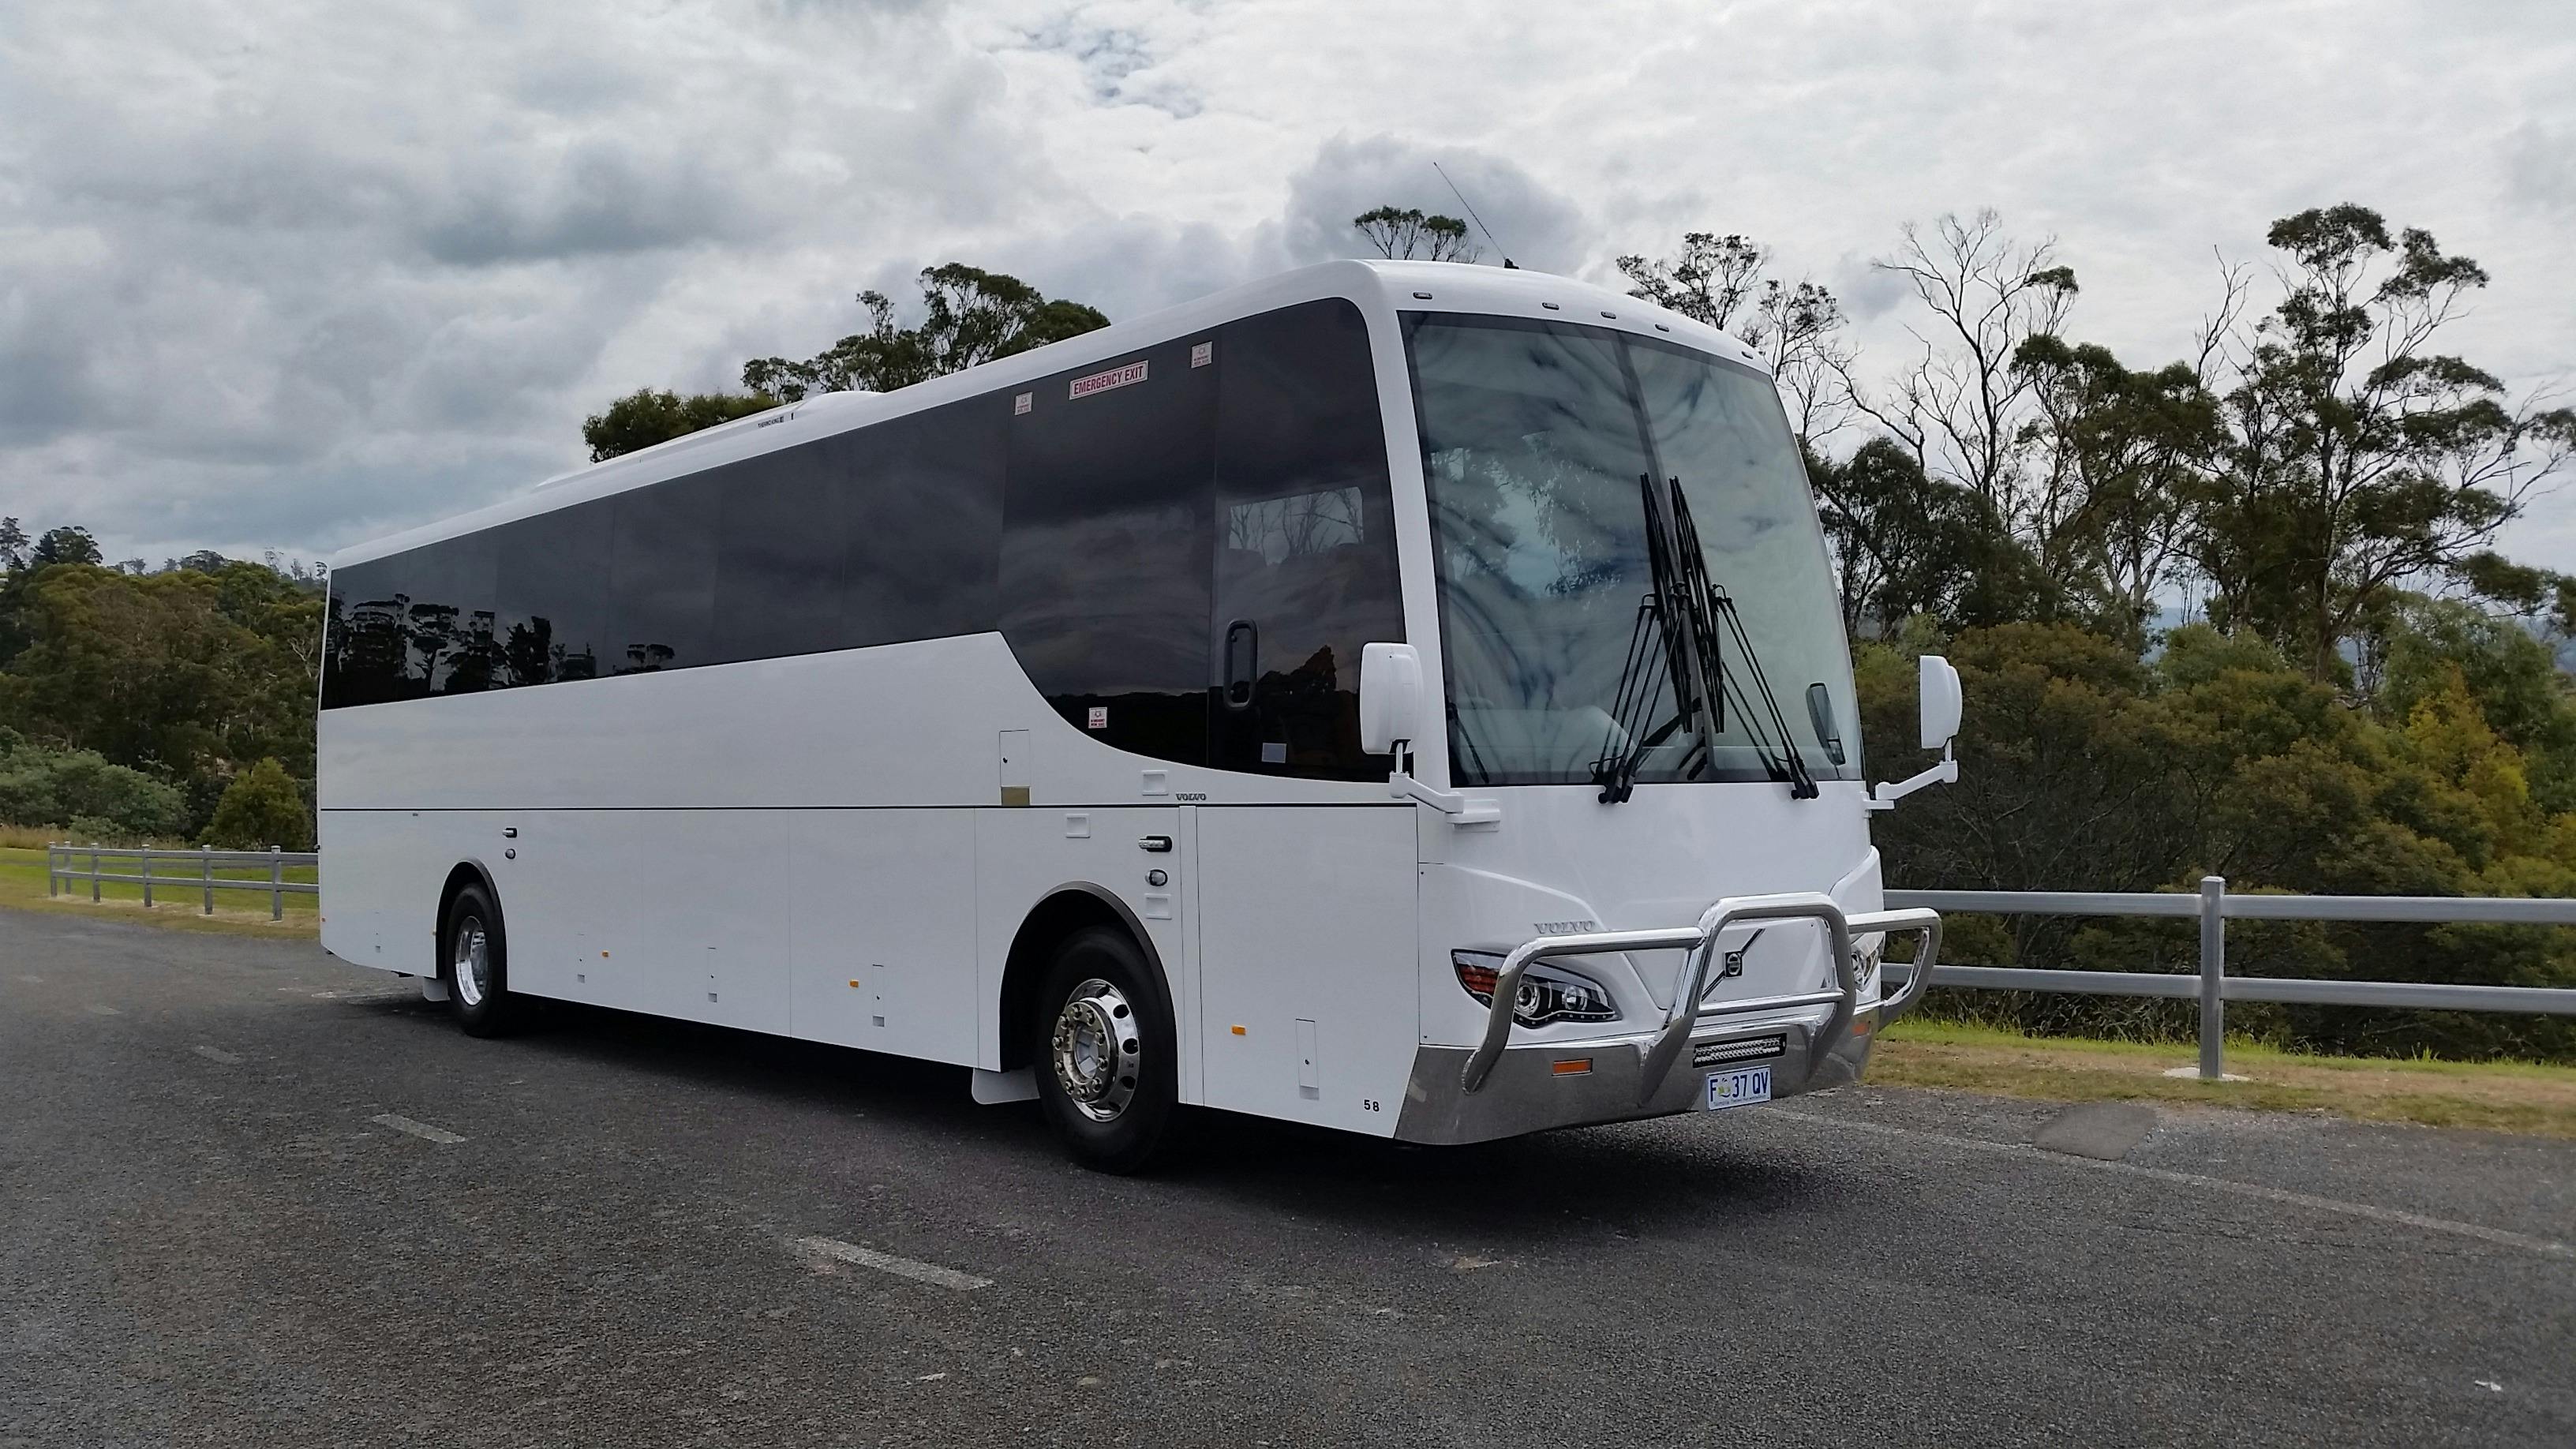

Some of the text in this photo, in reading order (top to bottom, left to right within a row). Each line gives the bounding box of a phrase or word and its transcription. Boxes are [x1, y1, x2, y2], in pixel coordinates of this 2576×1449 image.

[1074, 366, 1144, 395] EMERGENCY EXIT
[1534, 921, 1595, 934] VOLVO
[1709, 1078, 1718, 1102] F
[1732, 1074, 1747, 1098] 37
[1752, 1071, 1769, 1095] QV
[1364, 1099, 1380, 1112] 58
